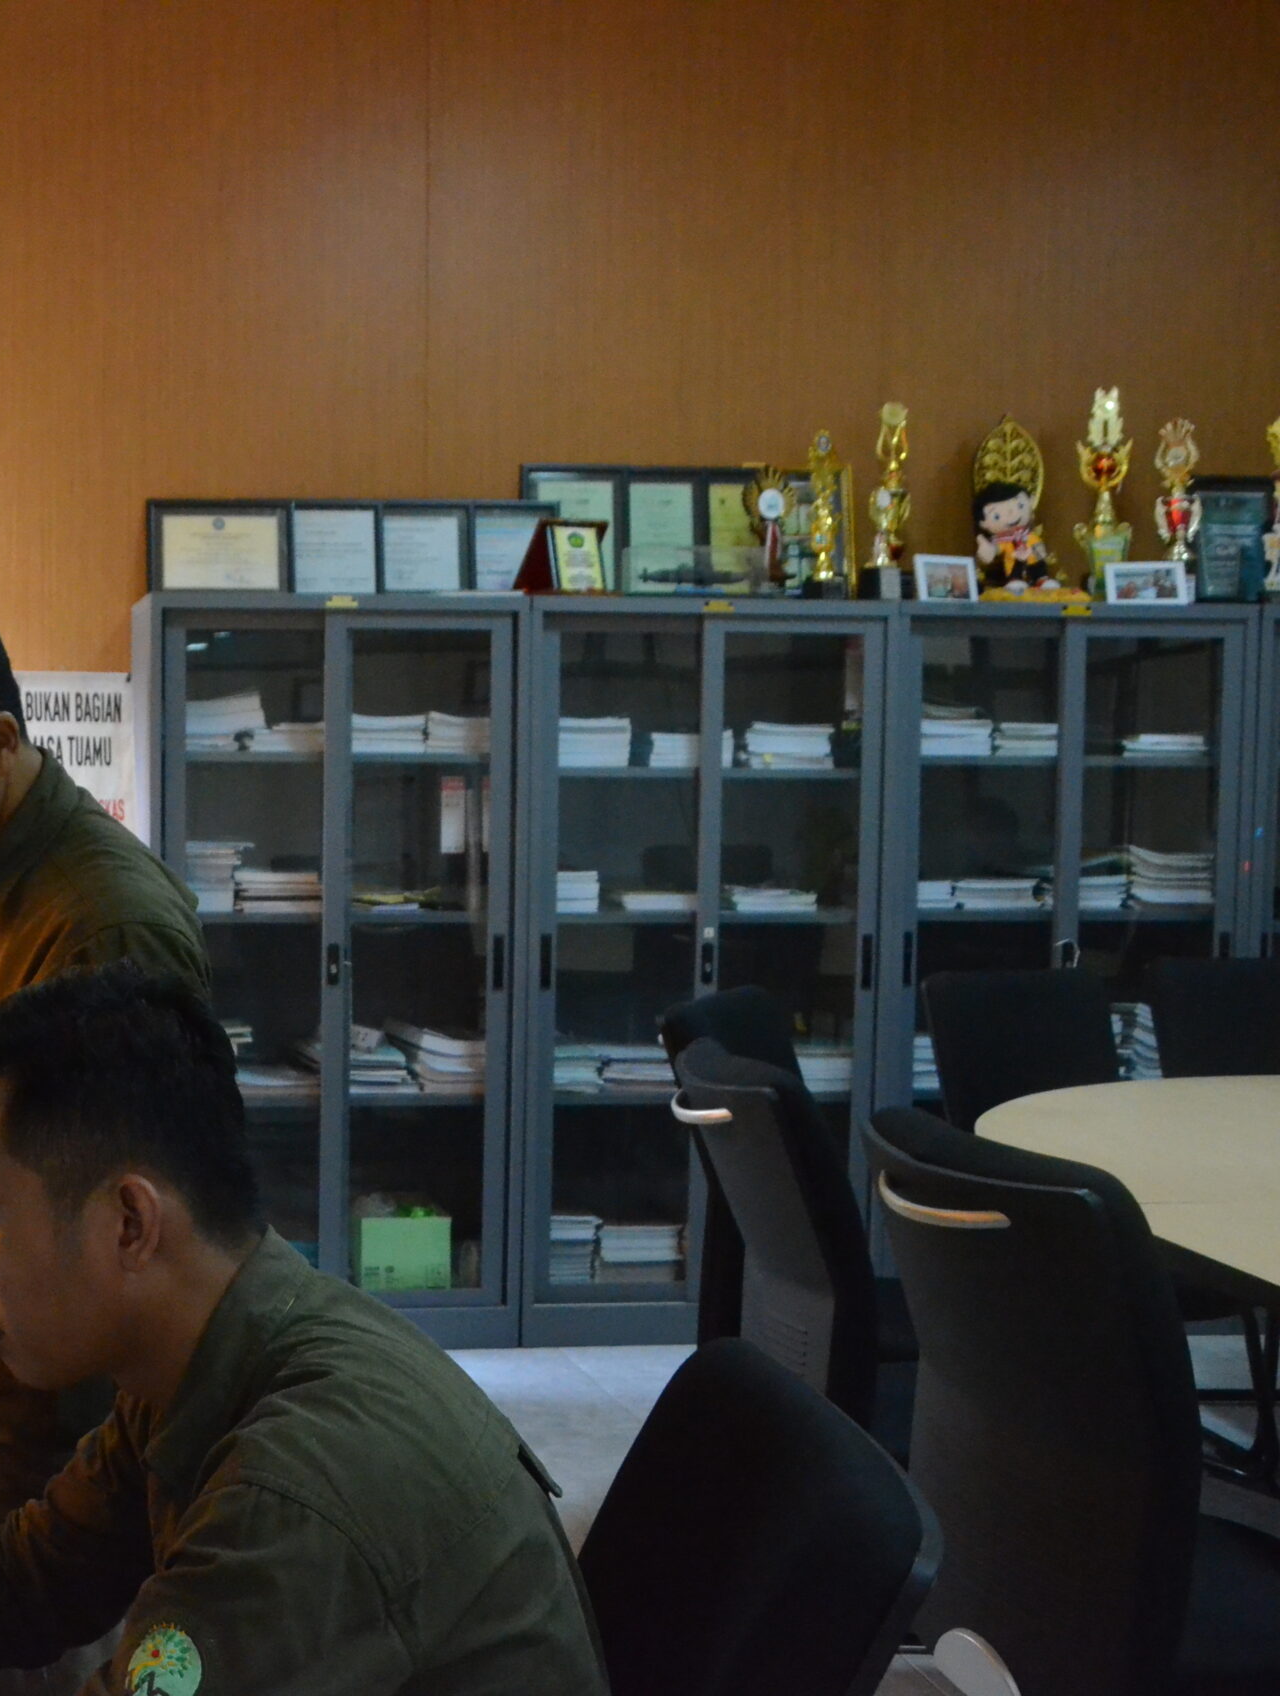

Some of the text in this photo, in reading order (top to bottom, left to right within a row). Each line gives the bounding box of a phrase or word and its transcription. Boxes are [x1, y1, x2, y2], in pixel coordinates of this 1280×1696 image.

[25, 691, 122, 723] BUKAN BAGIAN
[68, 736, 112, 767] TUAMU
[99, 799, 125, 821] AS
